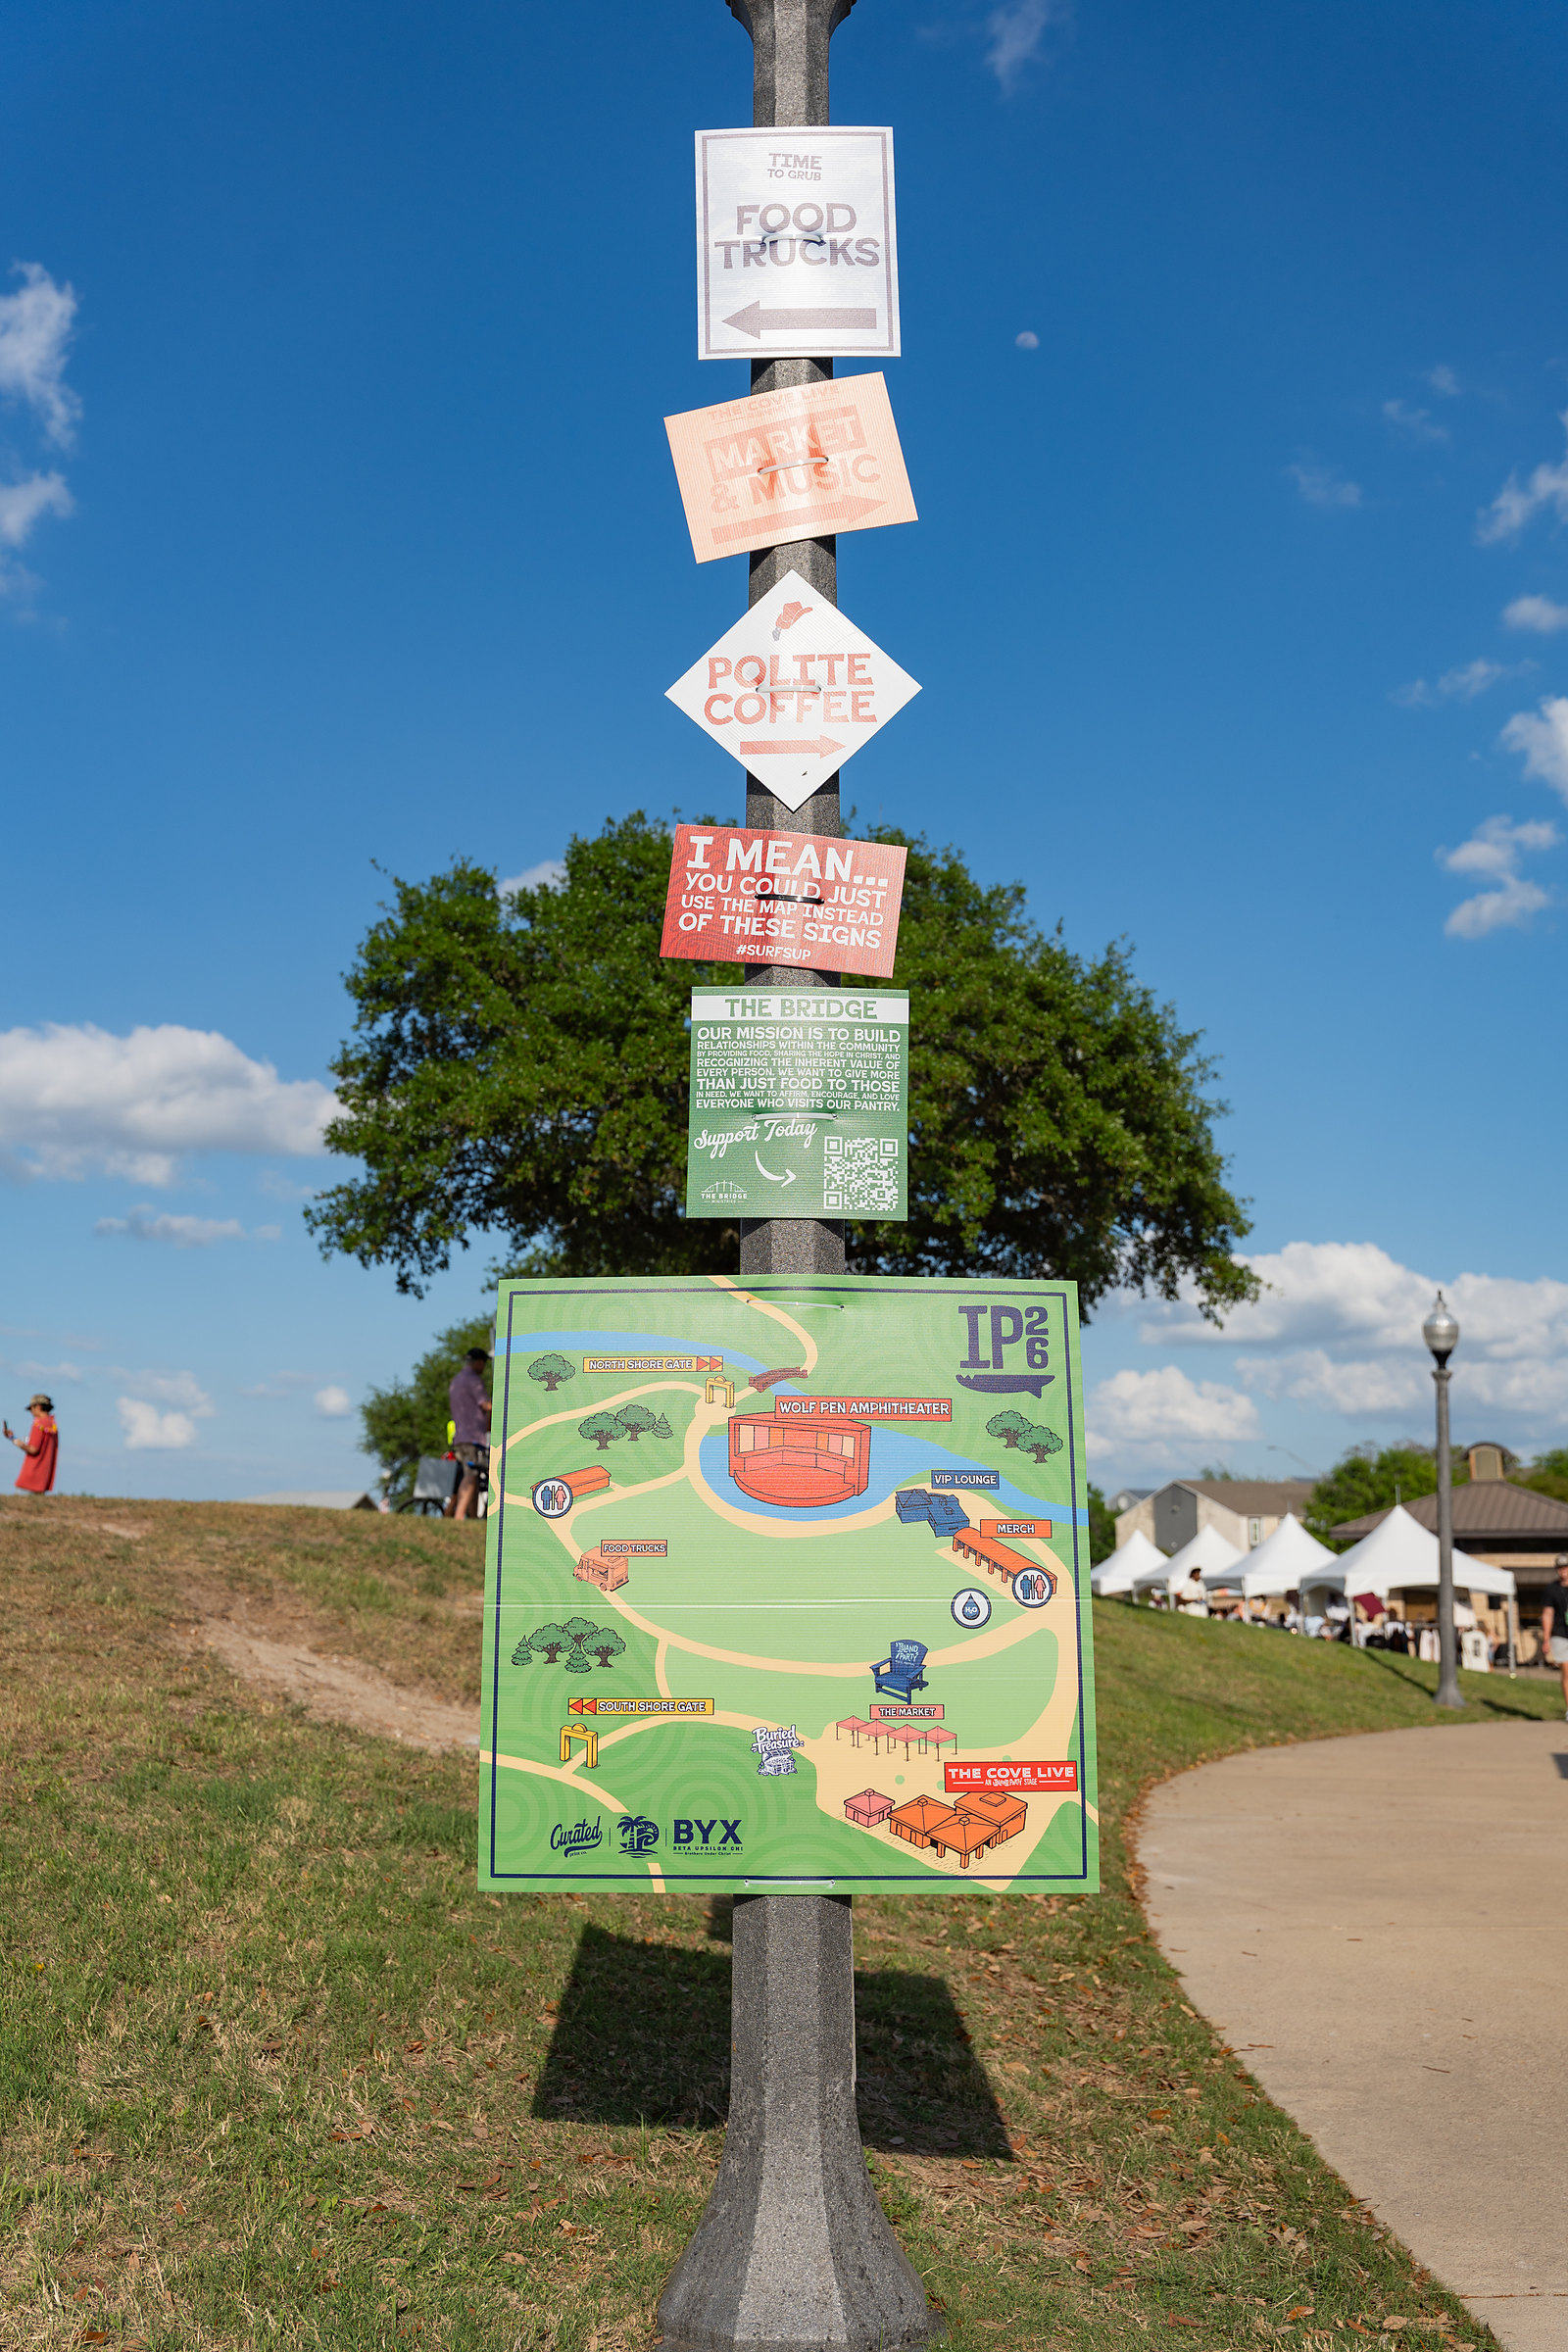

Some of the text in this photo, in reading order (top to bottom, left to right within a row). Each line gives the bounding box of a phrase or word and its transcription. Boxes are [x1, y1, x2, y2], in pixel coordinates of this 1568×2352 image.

[768, 153, 822, 171] TIME
[767, 169, 821, 181] TO GRUB
[736, 202, 857, 235] FOOD
[714, 237, 880, 269] TRUCKS
[708, 404, 743, 421] THE
[748, 393, 794, 411] COVE
[710, 415, 857, 469] MARKET
[710, 453, 881, 514] & MUSIC
[708, 653, 874, 689] POLITE
[704, 690, 877, 726] COFFEE
[686, 835, 889, 887] I MEAN...
[685, 872, 887, 908] YOU COULD JUST
[681, 894, 884, 926] USE THE MAP INSTEAD
[678, 912, 882, 949] OF THESE SIGNS
[736, 944, 811, 960] #SURFSUP
[724, 999, 878, 1019] THE BRIDGE
[697, 1026, 901, 1043] OUR MISSION IS TO BUILD
[697, 1041, 901, 1053] RELATIONSHIPS WITHIN THE COMMUNITY
[697, 1057, 901, 1070] RECOGNIZING THE INHERENT VALUE OF
[697, 1068, 729, 1077] EVERY
[731, 1067, 775, 1076] PERSON.
[778, 1067, 794, 1076] WE
[797, 1068, 826, 1077] WANT
[845, 1069, 868, 1078] GIVE
[870, 1070, 901, 1080] MORE
[696, 1077, 901, 1093] THAN JUST FOOD TO THOSE
[811, 1091, 860, 1101] ENCOURAGE,
[696, 1099, 901, 1112] EVERYONE WHO VISITS OUR PANTRY.
[694, 1119, 818, 1159] Support Today
[958, 1304, 1024, 1369] IP
[589, 1359, 693, 1370] NORTH SHORE GATE
[779, 1401, 950, 1415] WOLF PEN AMPHITHEATER
[934, 1475, 997, 1484] VIP LOUNGE
[997, 1524, 1035, 1534] MERCH
[598, 1701, 706, 1712] SOUTH SHORE GATE
[752, 1724, 796, 1742] Buried
[752, 1739, 800, 1753] Treasure
[948, 1767, 1074, 1779] THE COVE LIVE
[550, 1815, 602, 1850] Curated
[673, 1819, 743, 1844] BYX
